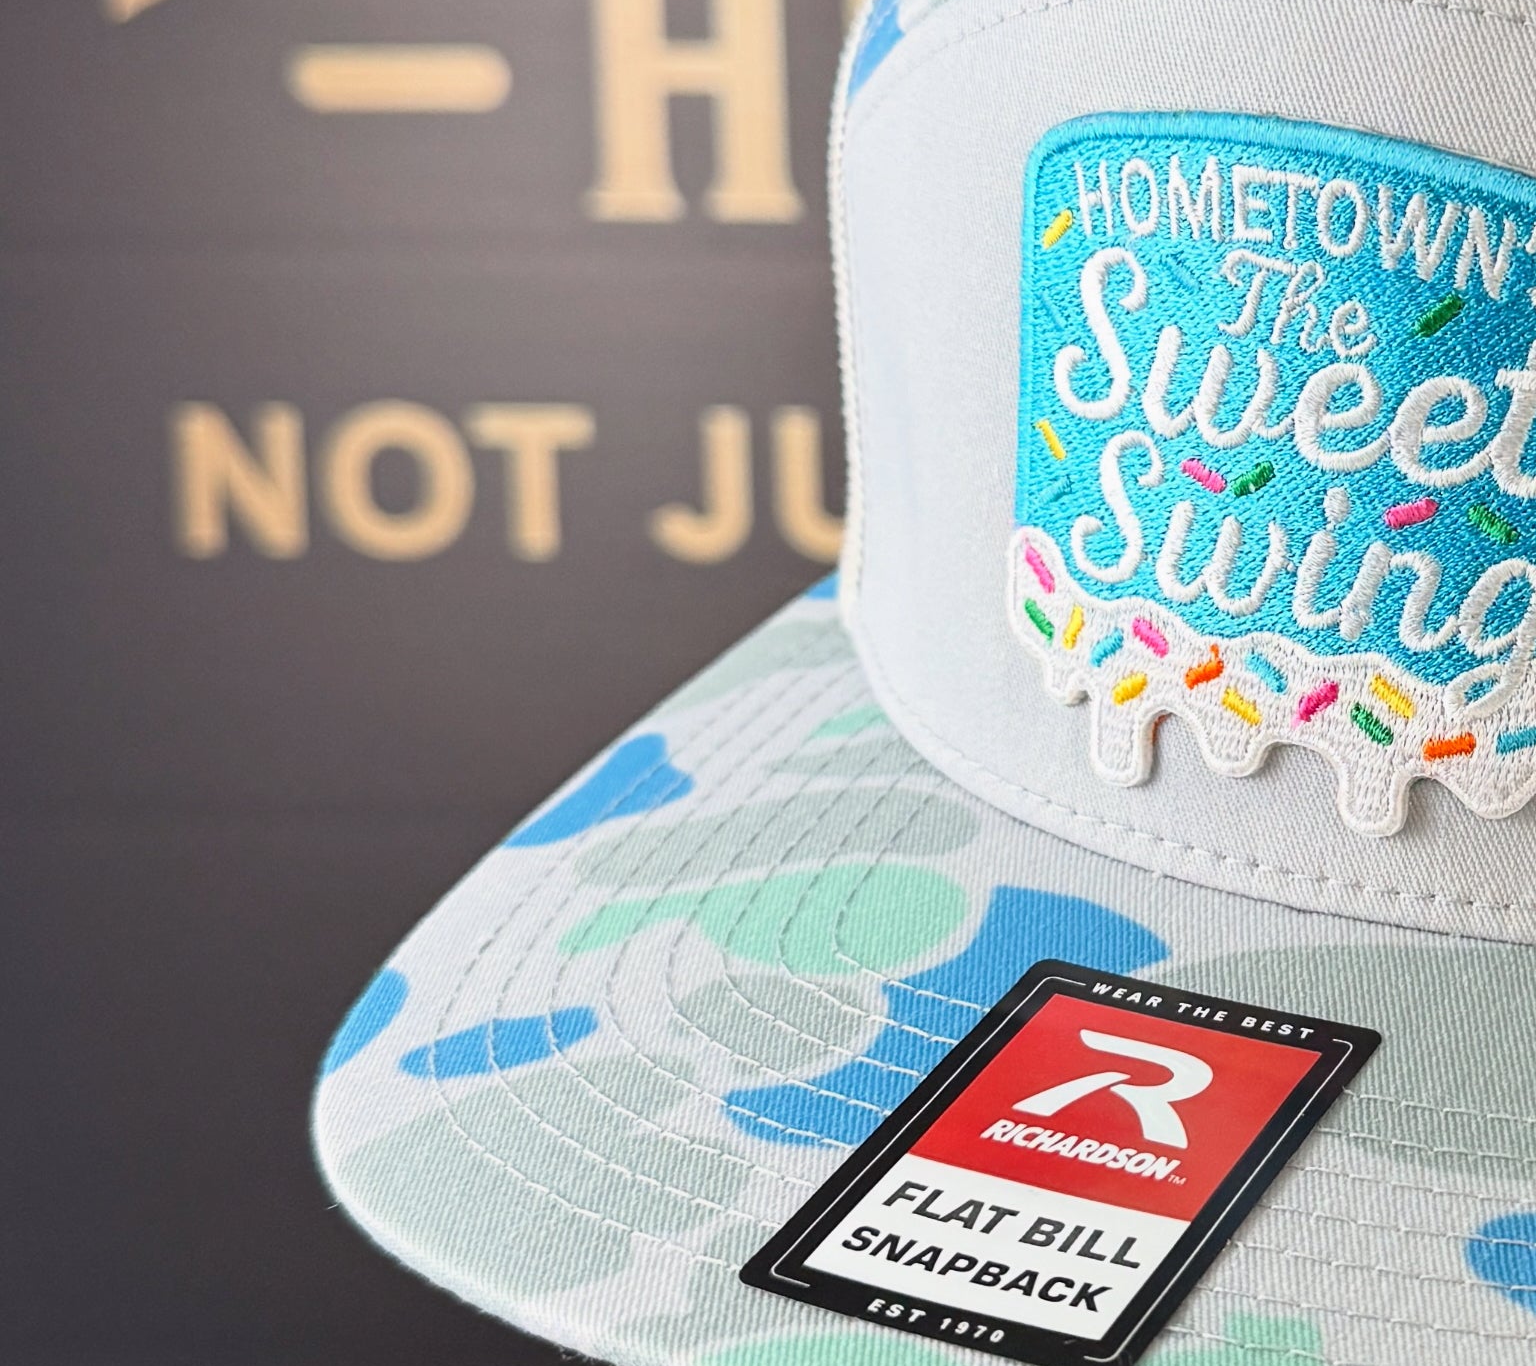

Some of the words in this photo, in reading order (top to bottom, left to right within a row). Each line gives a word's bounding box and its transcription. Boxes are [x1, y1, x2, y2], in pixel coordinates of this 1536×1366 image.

[1217, 249, 1378, 357] The
[170, 398, 597, 561] NOT
[1092, 982, 1162, 1008] WEAR
[1177, 1002, 1227, 1023] THE
[1240, 1016, 1315, 1039] BEST
[980, 1120, 1183, 1183] RICHARDSON
[883, 1180, 1020, 1236] FLAT
[1018, 1219, 1142, 1269] BILL
[841, 1225, 1114, 1312] SNAPBACK
[868, 1298, 927, 1321] EST
[940, 1318, 1005, 1344] 1970
